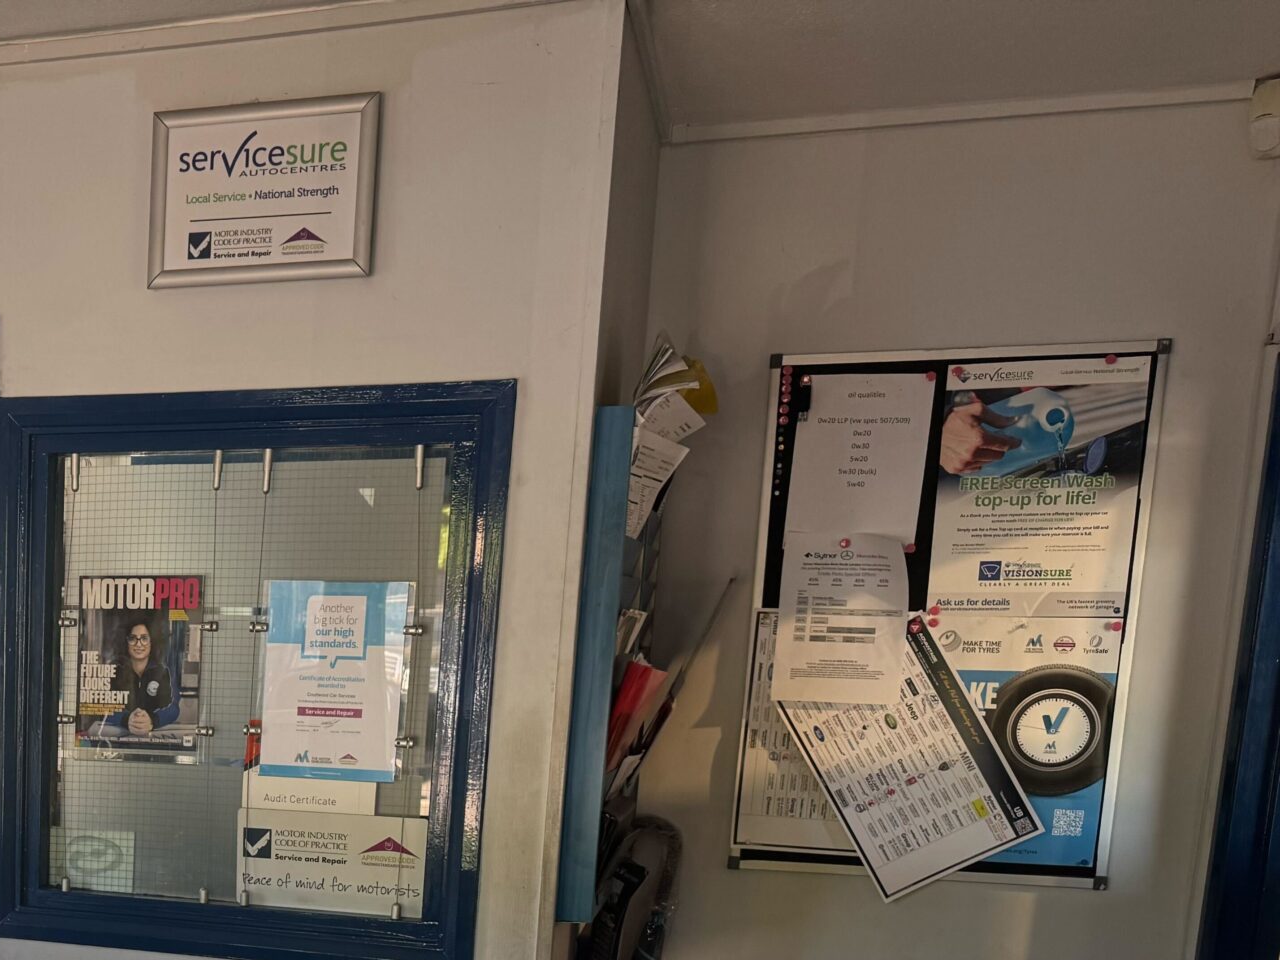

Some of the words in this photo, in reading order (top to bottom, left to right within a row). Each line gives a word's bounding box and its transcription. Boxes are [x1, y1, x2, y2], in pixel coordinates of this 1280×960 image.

[179, 130, 347, 178] servicesure
[239, 163, 347, 178] AUTOCENTRES
[186, 194, 210, 204] Local
[212, 192, 246, 203] Service
[254, 187, 295, 200] National
[297, 185, 339, 200] Strength
[214, 230, 238, 238] MOTOR
[240, 228, 272, 236] INDUSTRY
[214, 251, 236, 259] Service
[251, 249, 272, 258] Repair
[857, 391, 886, 402] qualities
[863, 418, 879, 426] spec
[857, 468, 877, 476] (bulk)
[960, 475, 999, 492] FREE
[1003, 474, 1061, 491] Screen
[1068, 473, 1115, 488] Wash
[974, 491, 1032, 510] top-up
[1036, 492, 1061, 506] for
[1065, 490, 1097, 505] life!
[1003, 569, 1072, 578] VISIONSURE
[82, 577, 200, 610] MOTORPRO
[318, 603, 354, 614] Another
[936, 598, 952, 607] Ask
[966, 598, 979, 606] for
[980, 598, 1011, 607] details
[313, 615, 327, 626] big
[329, 615, 345, 625] tick
[346, 616, 358, 625] for
[315, 628, 332, 637] our
[333, 628, 355, 640] high
[309, 639, 359, 649] standards.
[81, 650, 99, 664] THE
[80, 664, 117, 678] FUTURE
[79, 677, 111, 691] LOOKS
[79, 691, 130, 704] DIFFERENT
[336, 709, 354, 717] Repair
[905, 701, 919, 721] Jeep
[959, 751, 976, 772] MINI
[263, 793, 286, 804] Audit
[289, 794, 337, 807] Certificate
[275, 829, 305, 839] MOTOR
[307, 831, 348, 842] INDUSTRY
[275, 839, 295, 848] CODE
[296, 840, 309, 848] OF
[310, 840, 348, 851] PRACTICE
[275, 852, 303, 863] Service
[304, 854, 320, 863] and
[321, 855, 347, 867] Repair
[242, 872, 272, 887] Peace
[276, 872, 291, 889] of
[295, 877, 325, 892] mind
[329, 877, 352, 894] for
[357, 881, 420, 899] motorists
